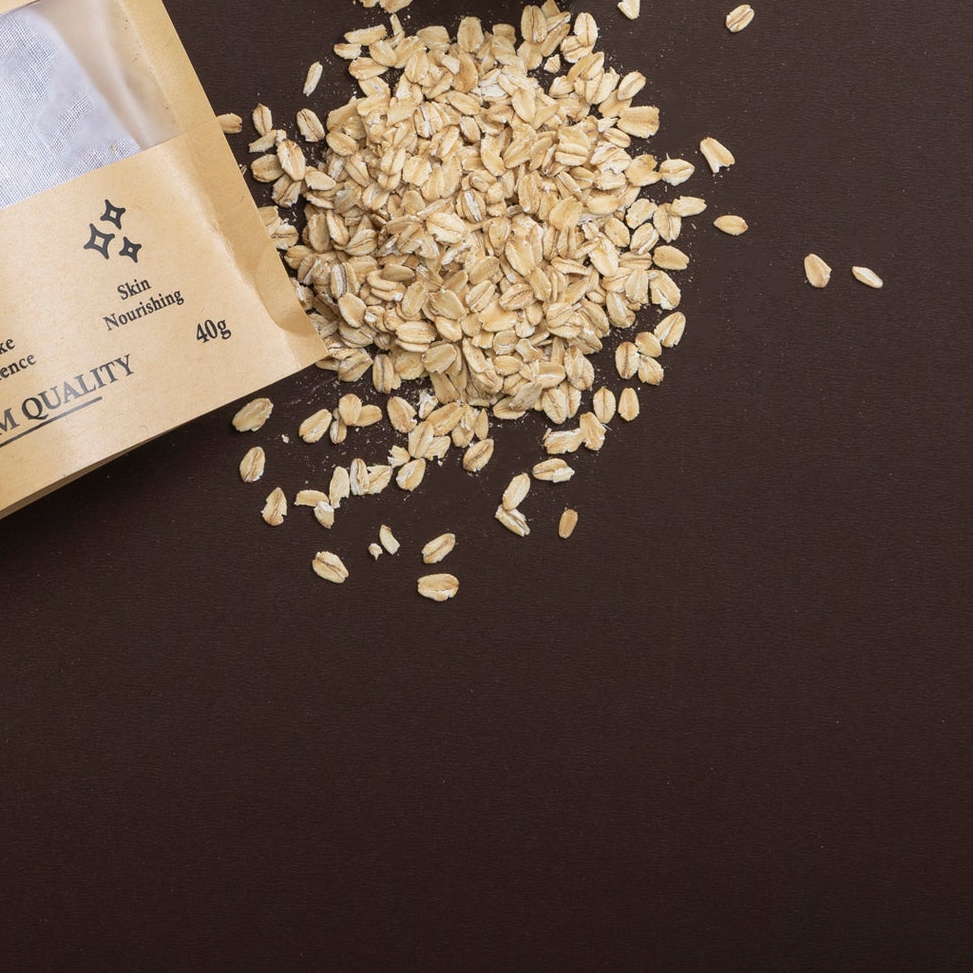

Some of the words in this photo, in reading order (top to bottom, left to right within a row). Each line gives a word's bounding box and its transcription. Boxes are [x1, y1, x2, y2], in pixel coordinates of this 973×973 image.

[117, 276, 152, 301] Skin
[103, 286, 185, 332] Nourishing
[195, 318, 232, 344] 40g
[20, 354, 135, 422] QUALITY
